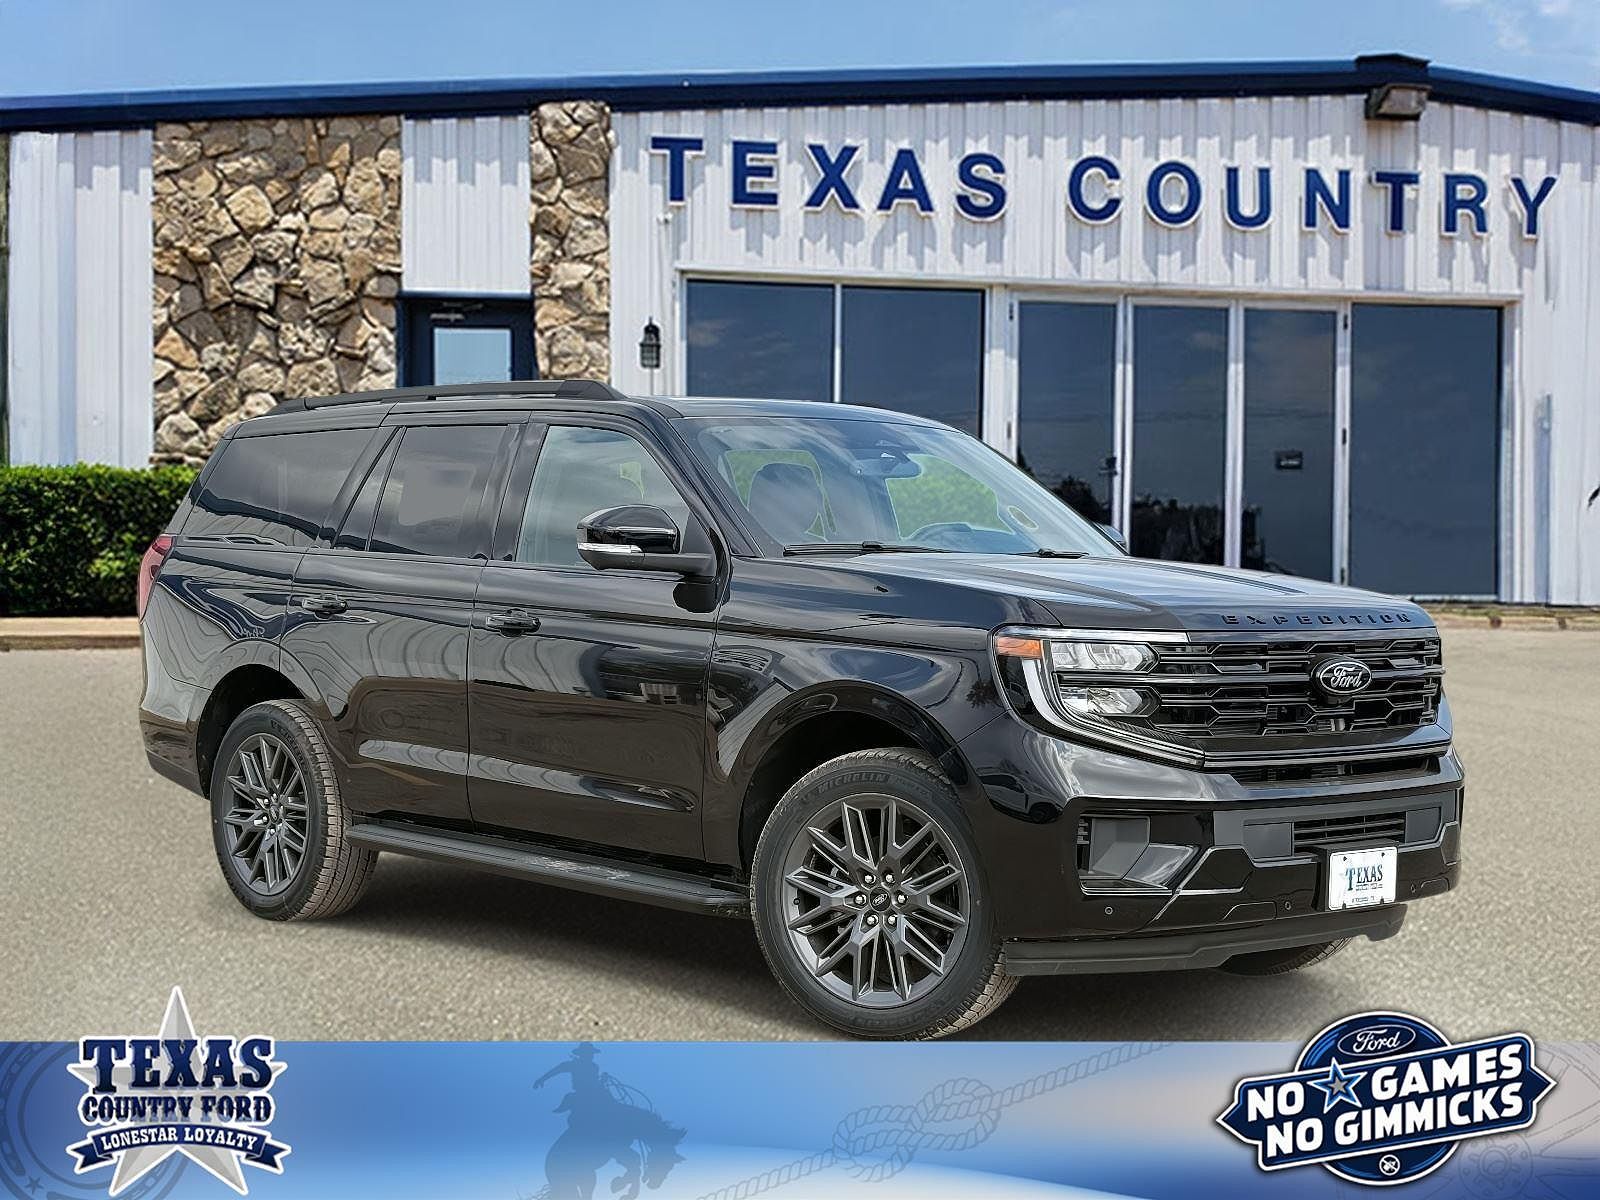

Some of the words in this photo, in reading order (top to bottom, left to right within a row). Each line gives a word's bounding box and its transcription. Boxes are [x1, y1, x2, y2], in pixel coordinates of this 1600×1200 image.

[650, 136, 1008, 219] TEXAS
[1067, 155, 1558, 240] COUNTRY
[1221, 612, 1412, 626] EXPEDITION
[1330, 666, 1364, 689] Ford
[1345, 863, 1384, 892] TEXAS
